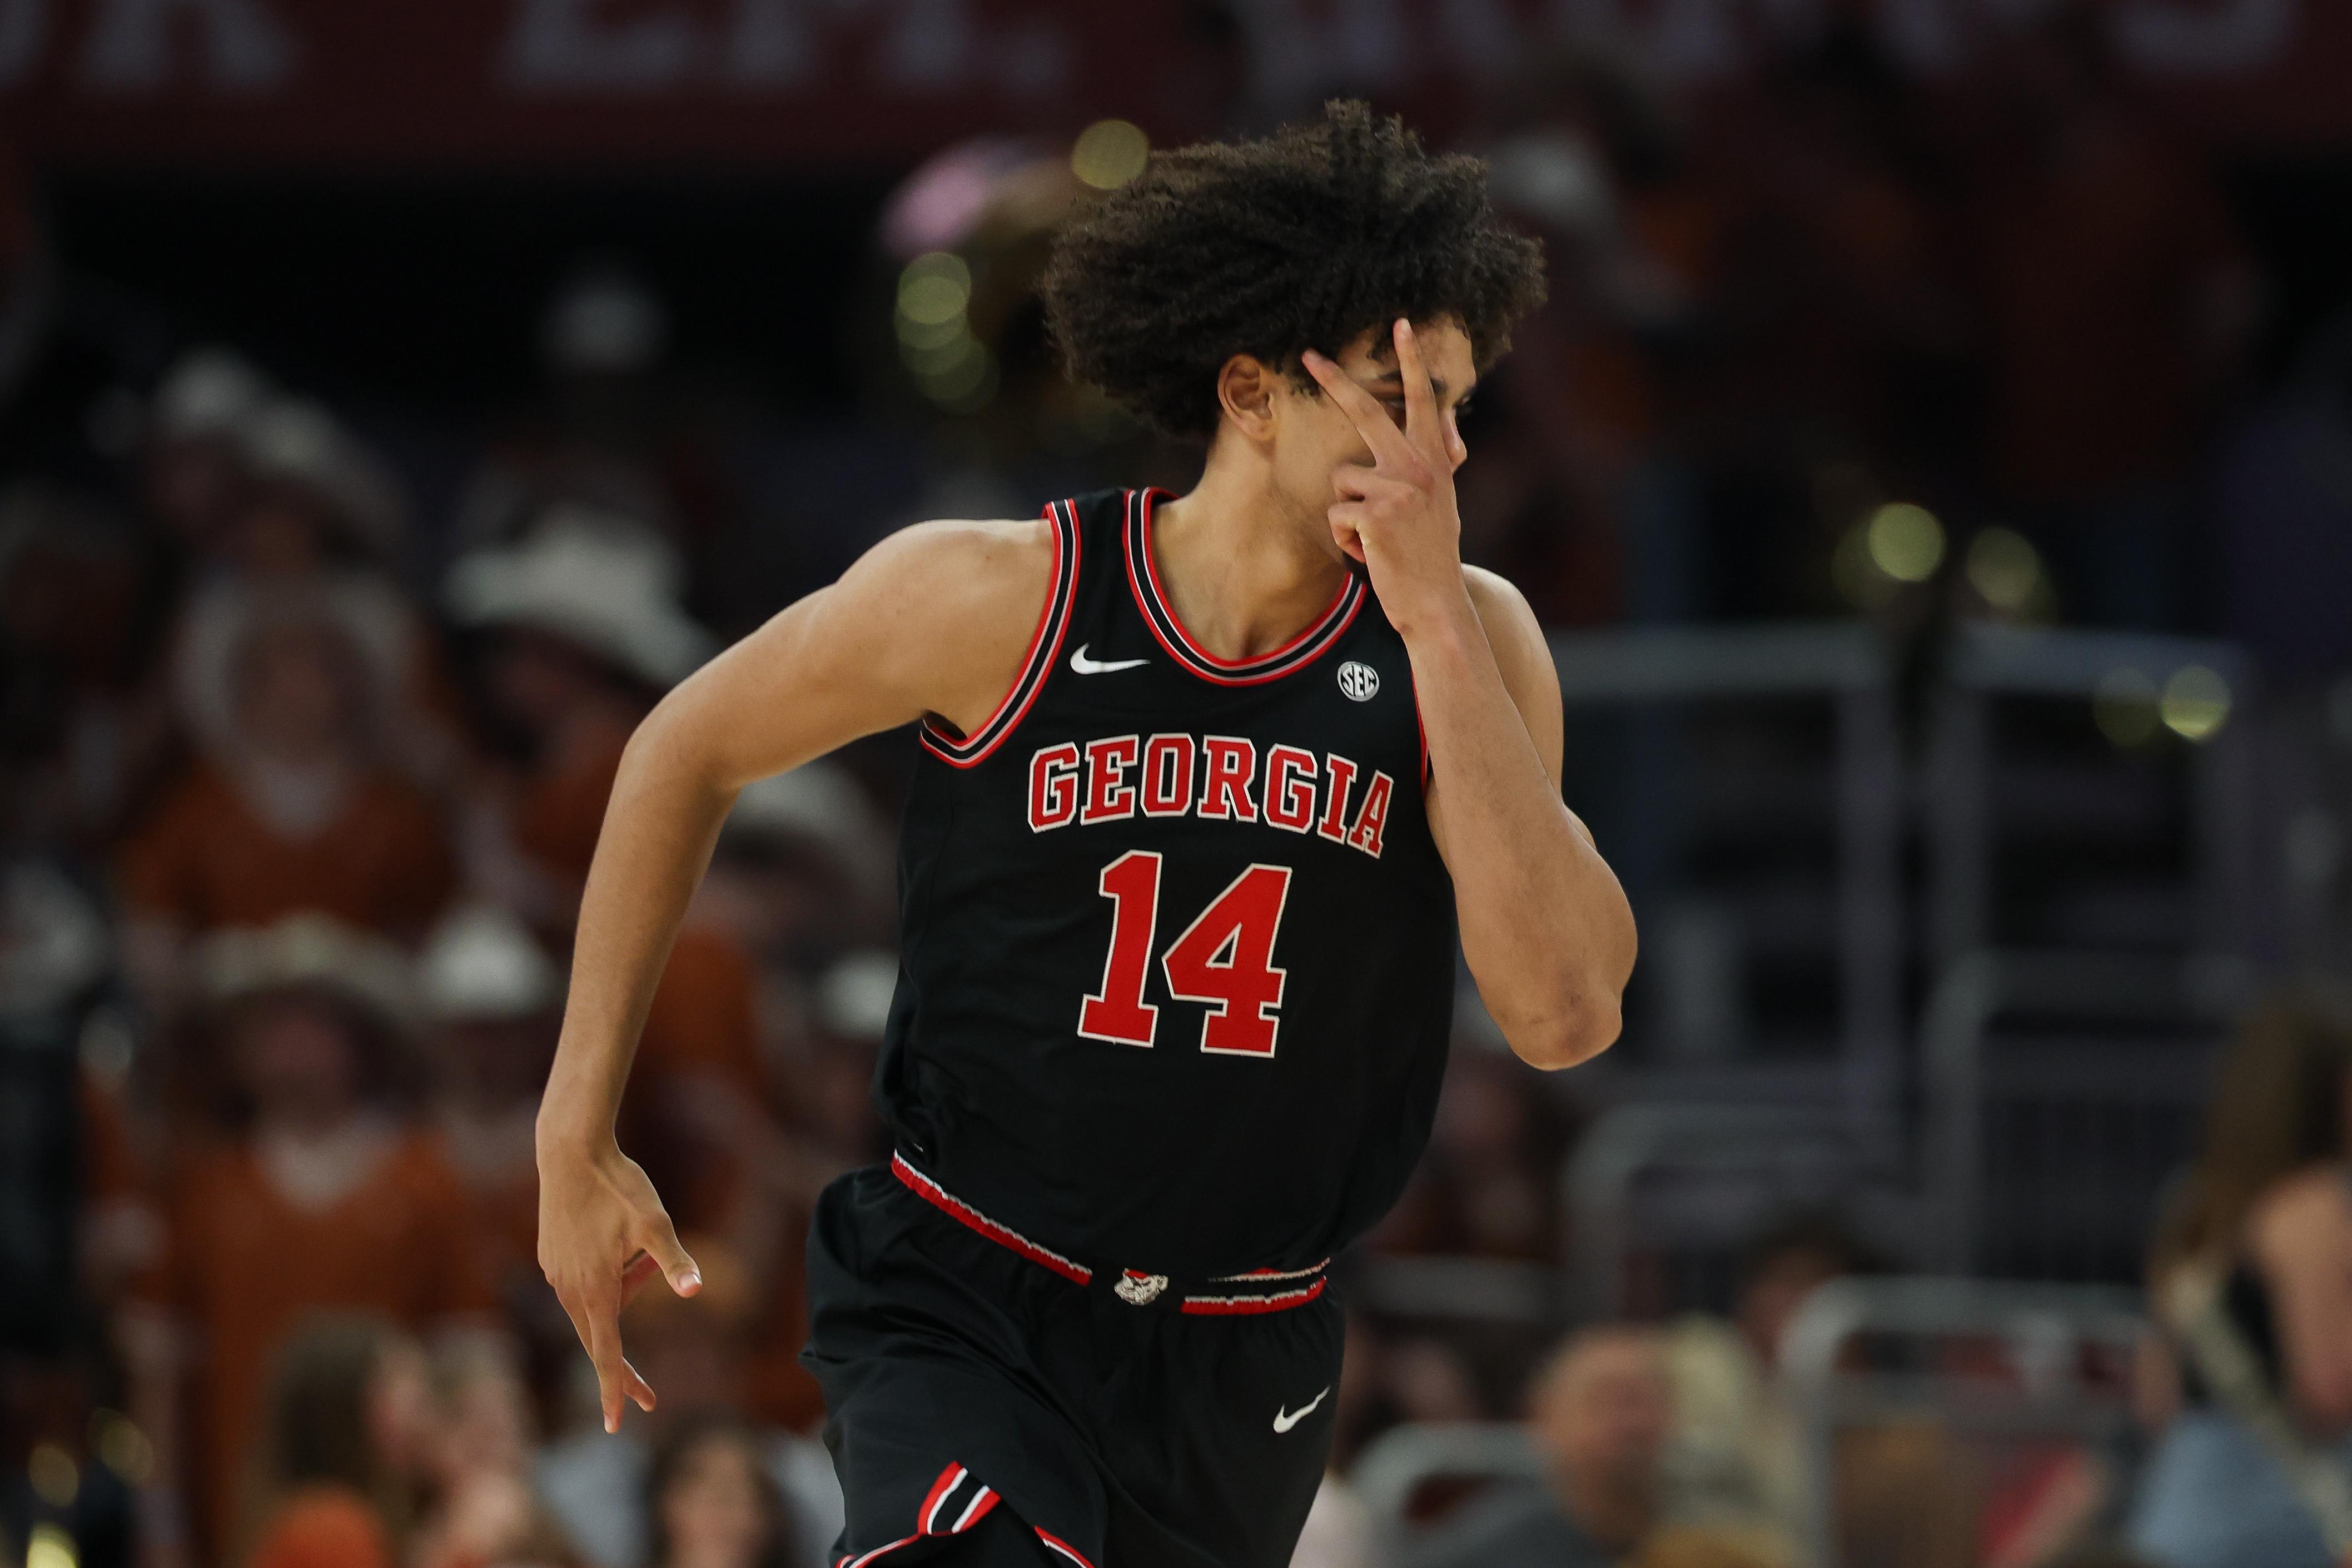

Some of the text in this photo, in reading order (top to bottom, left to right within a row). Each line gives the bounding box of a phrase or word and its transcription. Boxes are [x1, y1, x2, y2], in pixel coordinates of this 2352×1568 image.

[1342, 664, 1375, 697] SEC
[1028, 733, 1395, 859] GEORGIA
[1077, 849, 1293, 1058] 14
